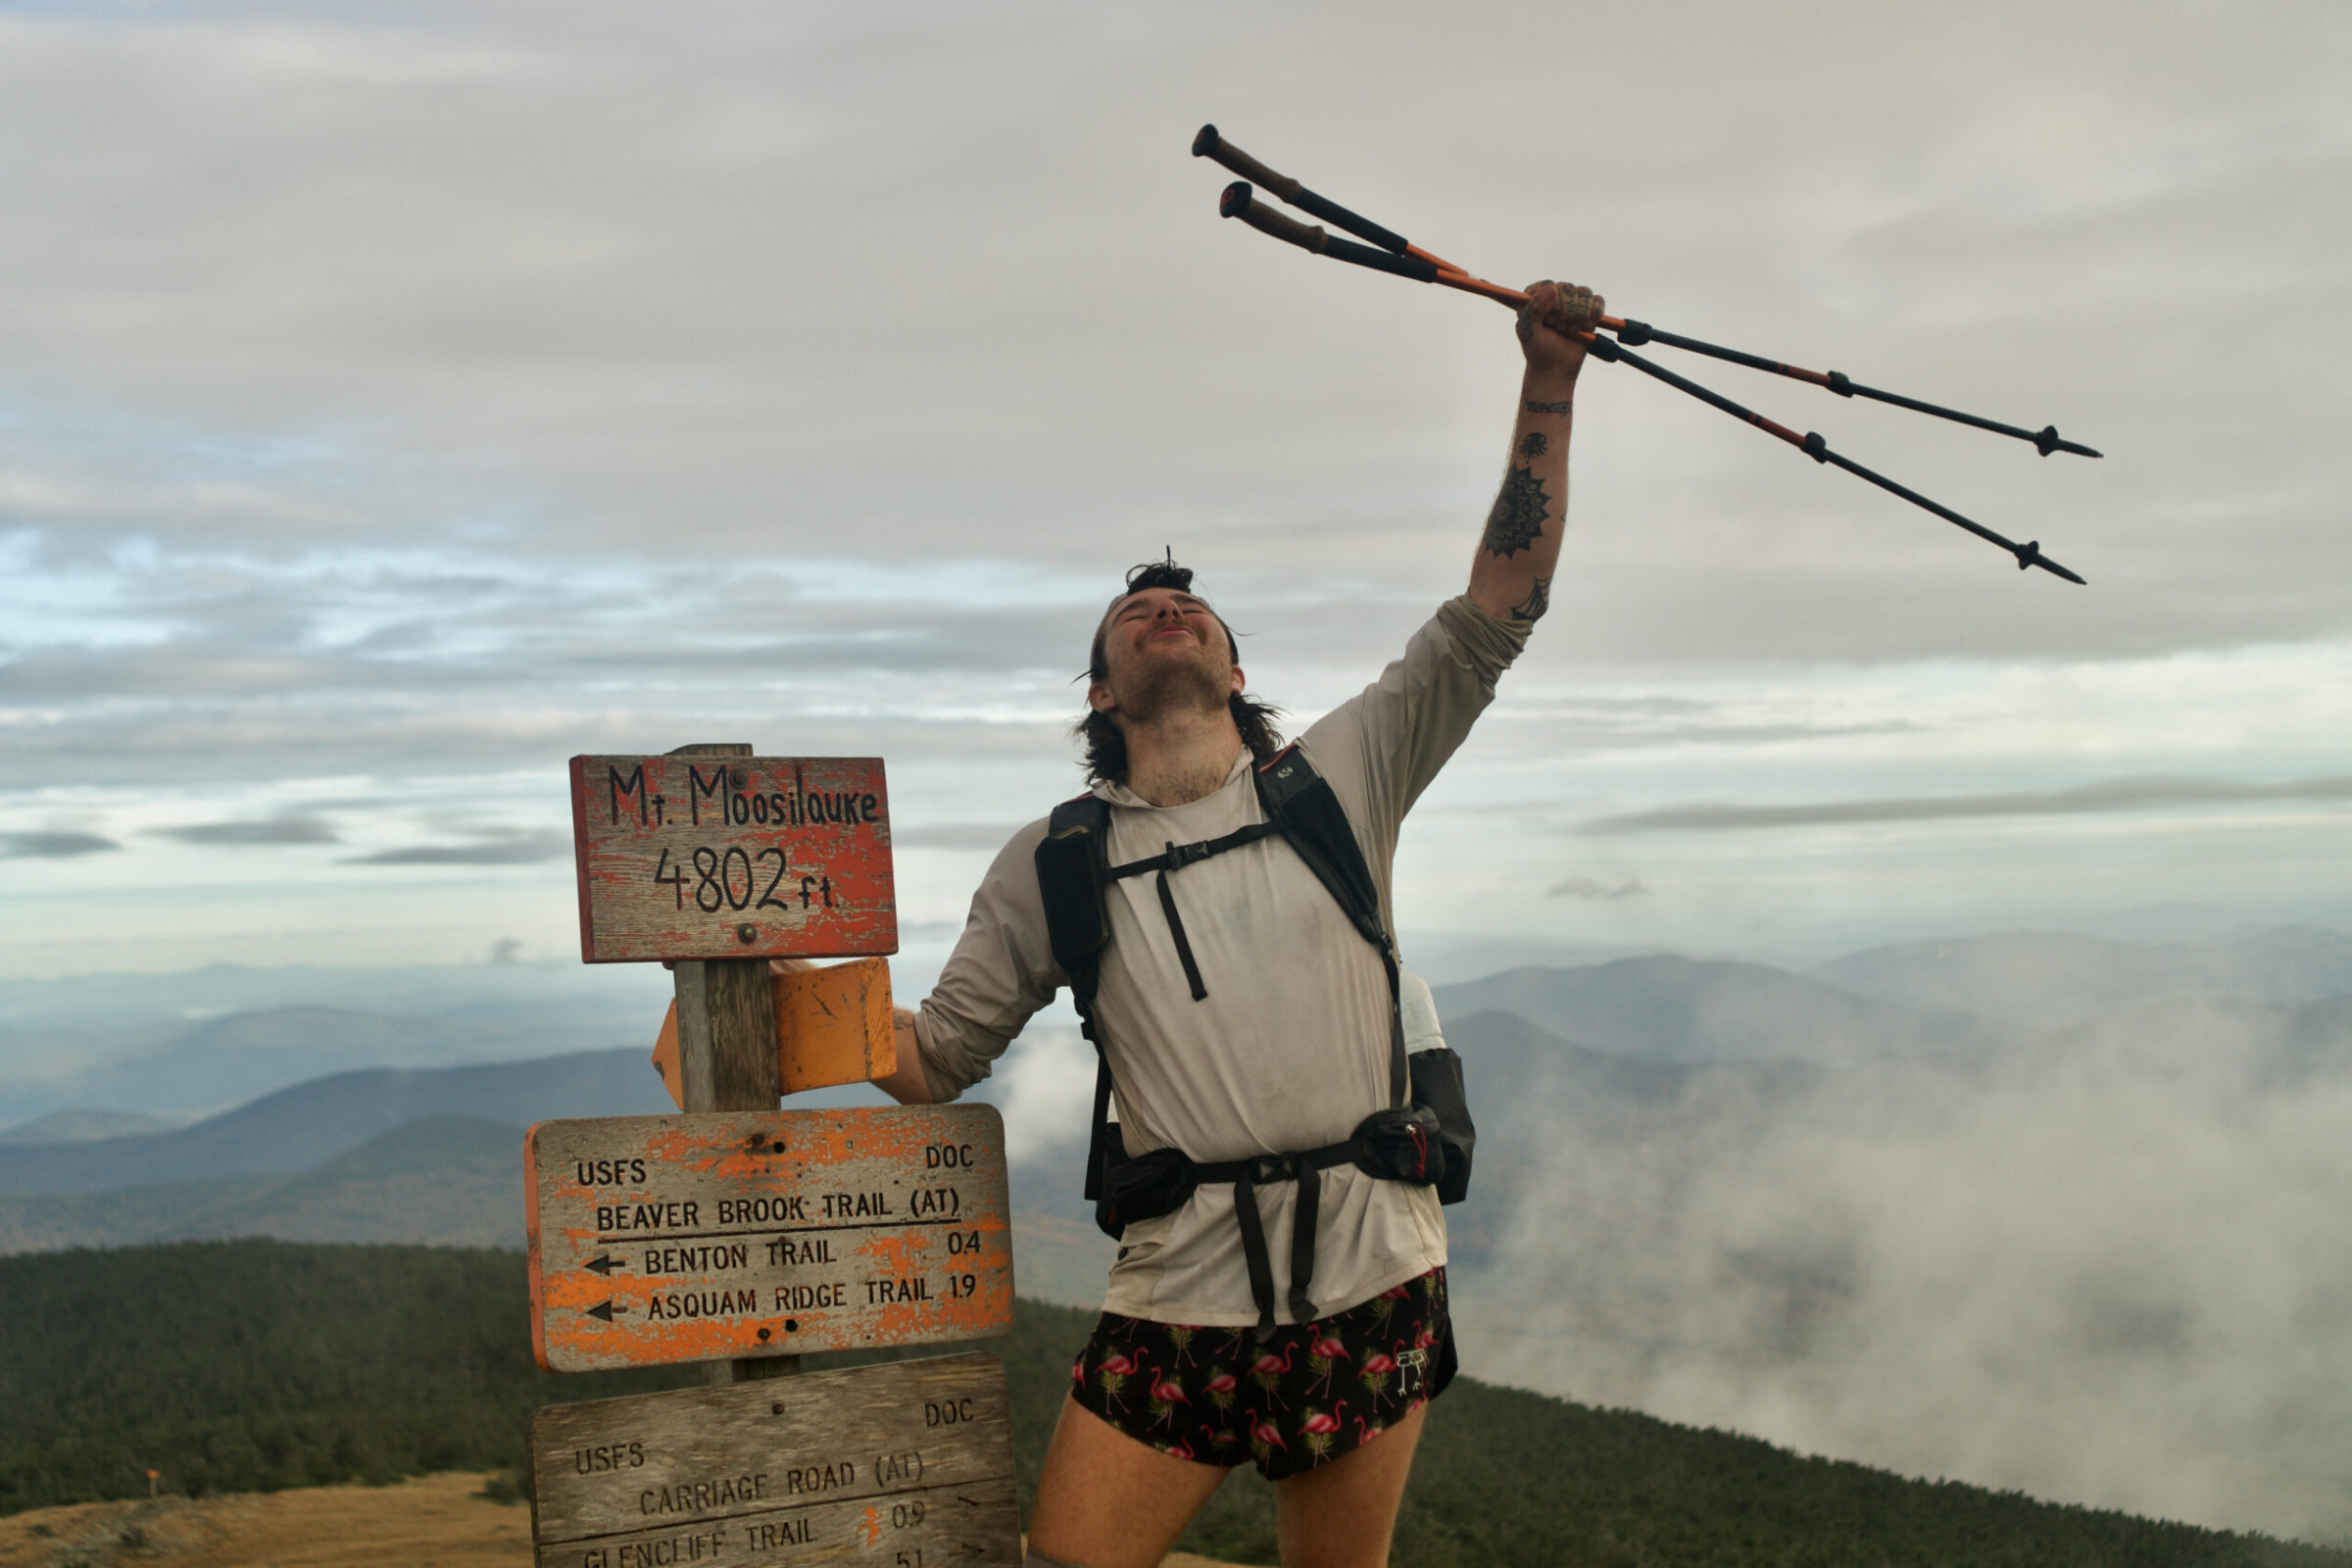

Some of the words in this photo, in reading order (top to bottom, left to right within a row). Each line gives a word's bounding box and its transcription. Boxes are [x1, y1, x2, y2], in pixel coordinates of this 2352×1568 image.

[609, 764, 673, 826] Mt.
[689, 763, 878, 826] Moosilauke
[654, 847, 788, 913] 4802
[576, 1158, 647, 1187] USFS
[926, 1144, 974, 1169] DOC
[597, 1201, 699, 1232] BEAVER
[718, 1196, 805, 1225] BROOK
[822, 1193, 893, 1218] TRAIL
[910, 1188, 959, 1216] (AT)
[645, 1246, 747, 1275] BENTON
[765, 1240, 837, 1266] TRAIL
[948, 1231, 981, 1255] 0.4
[648, 1289, 757, 1321] ASQUAM
[775, 1283, 847, 1311] RIDGE
[864, 1278, 934, 1305] TRAIL
[951, 1274, 977, 1298] 1.9
[925, 1398, 974, 1427] DOC
[575, 1444, 645, 1475] USFS
[639, 1474, 768, 1516] CARRIAGE
[787, 1462, 856, 1494] ROAD
[875, 1450, 924, 1488] (AT)
[745, 1518, 819, 1551] TRAIL
[892, 1500, 927, 1530] 0.9
